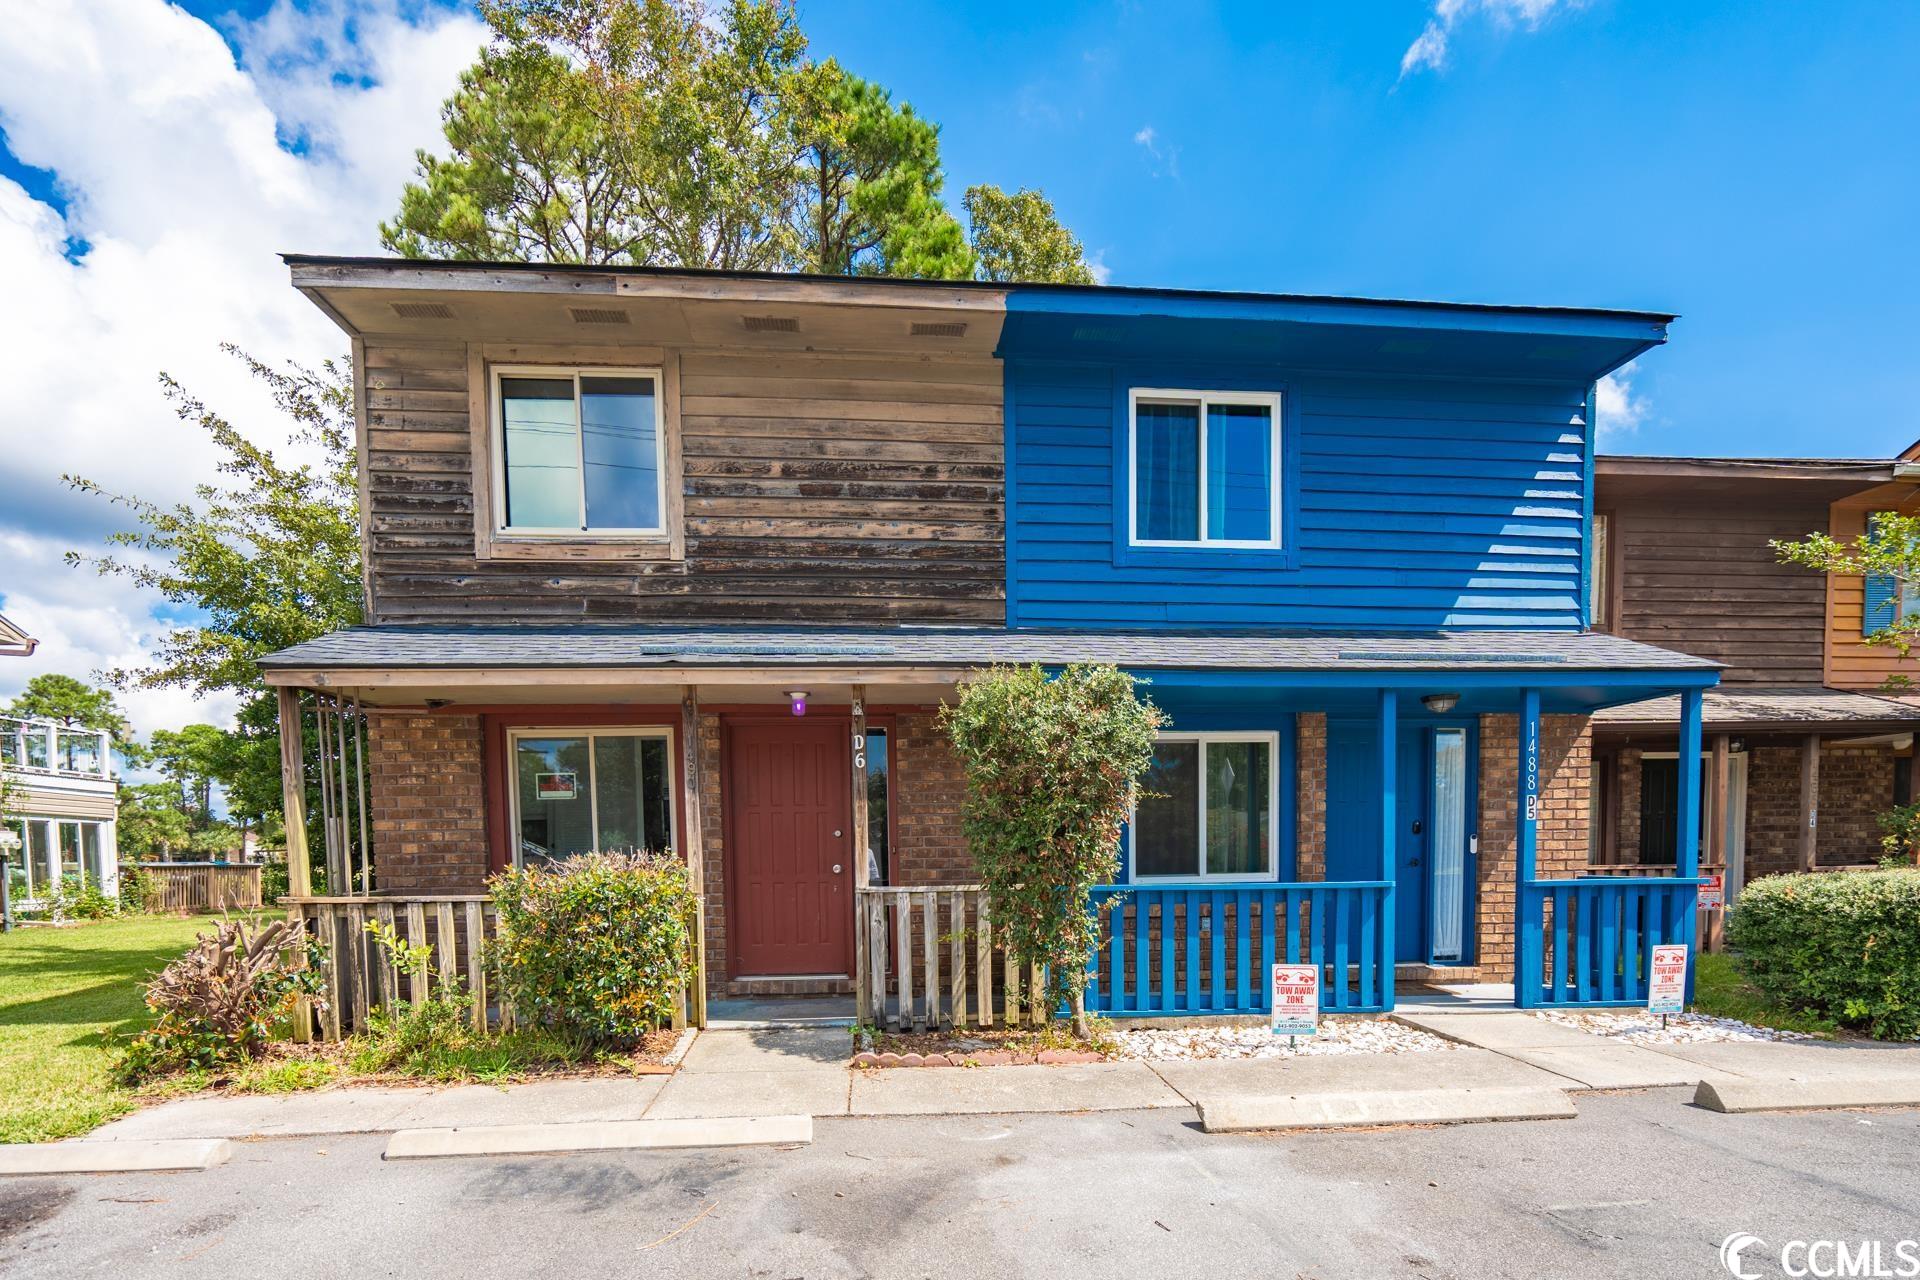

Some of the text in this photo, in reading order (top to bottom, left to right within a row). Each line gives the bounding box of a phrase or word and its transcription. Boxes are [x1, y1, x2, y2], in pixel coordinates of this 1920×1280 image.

[854, 735, 866, 768] D6
[1528, 721, 1536, 818] 1488 D5
[1654, 966, 1683, 975] TOW AWAY
[1661, 975, 1674, 983] ZONE
[1276, 987, 1315, 995] TOW AWAY
